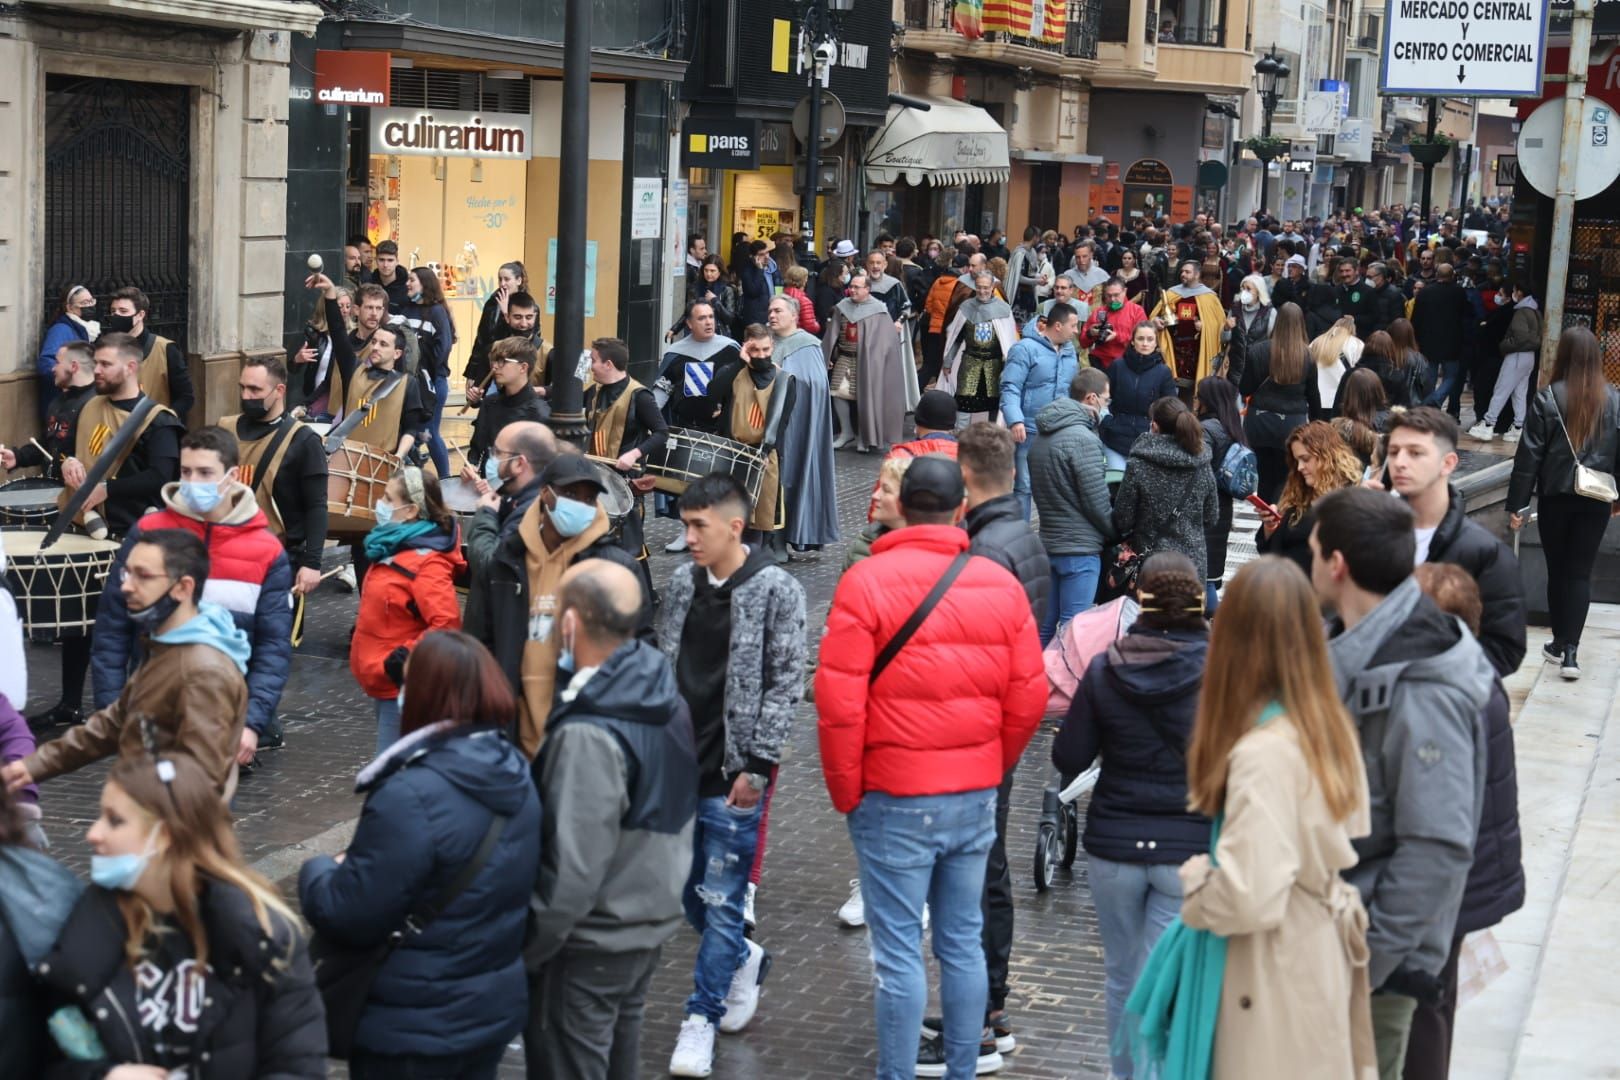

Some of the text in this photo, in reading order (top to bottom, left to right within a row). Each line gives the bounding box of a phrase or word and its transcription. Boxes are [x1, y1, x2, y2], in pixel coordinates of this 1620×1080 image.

[1400, 1, 1469, 19] MERCADO
[1473, 2, 1532, 21] CENTRAL
[1461, 22, 1469, 40] Y
[1394, 42, 1533, 62] CENTRO COMERCIAL
[318, 86, 384, 103] culinarium
[385, 115, 524, 152] culinarium
[709, 135, 748, 152] pans
[886, 152, 923, 168] Boutique
